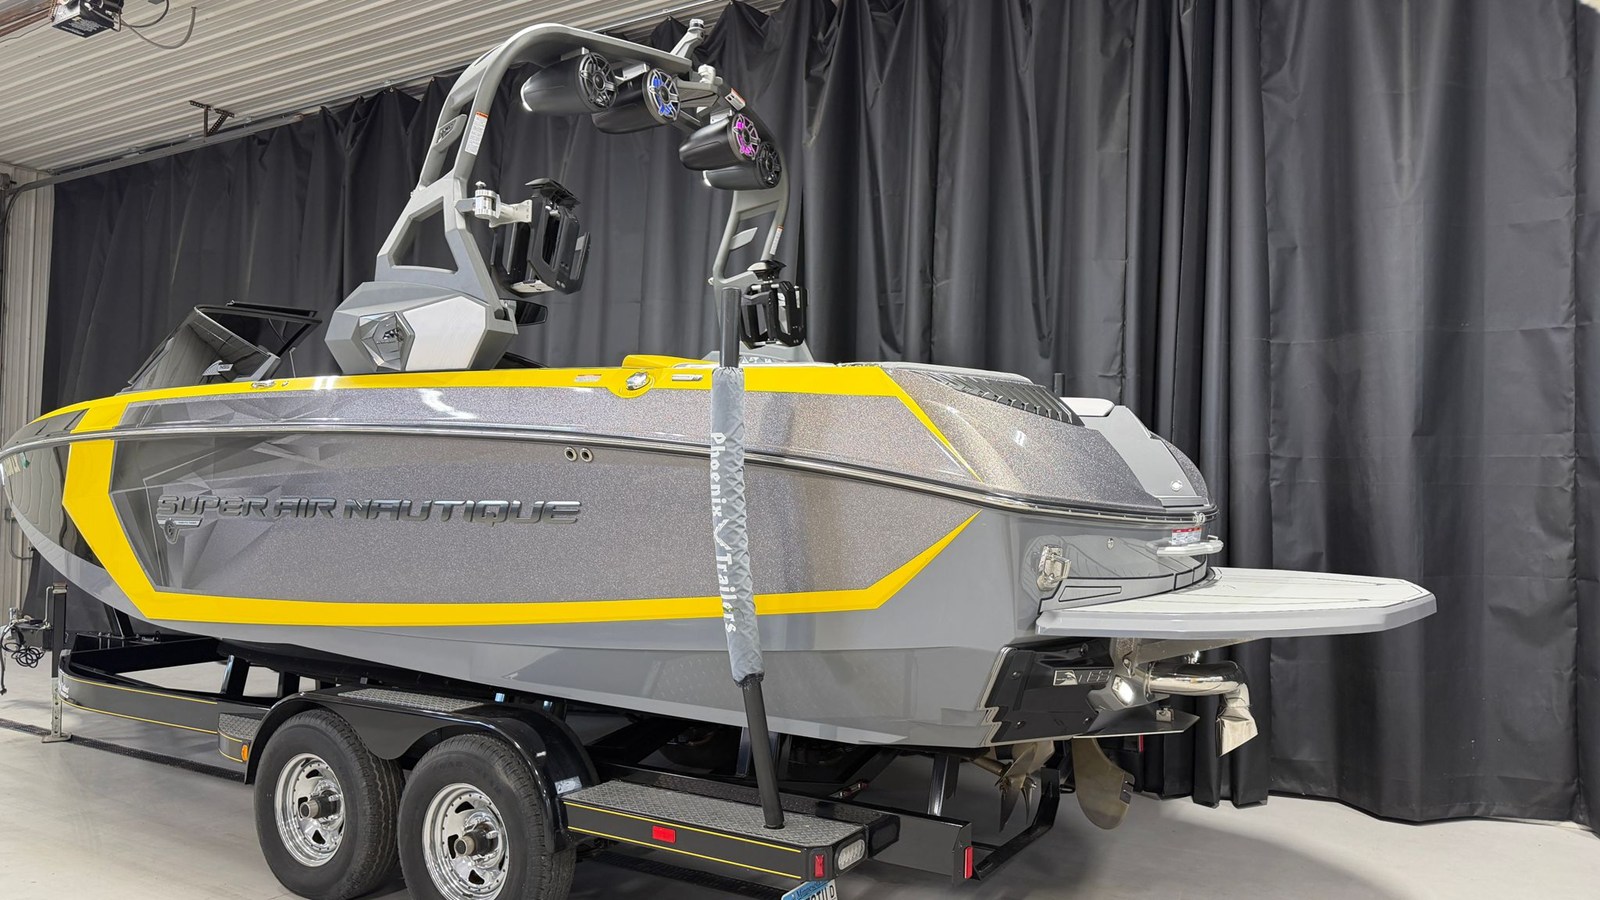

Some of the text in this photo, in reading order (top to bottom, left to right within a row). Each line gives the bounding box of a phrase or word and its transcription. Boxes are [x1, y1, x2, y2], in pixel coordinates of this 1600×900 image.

[156, 495, 583, 527] SUPER AIR NAUTIQUE
[710, 432, 738, 633] Phoenix Trailers
